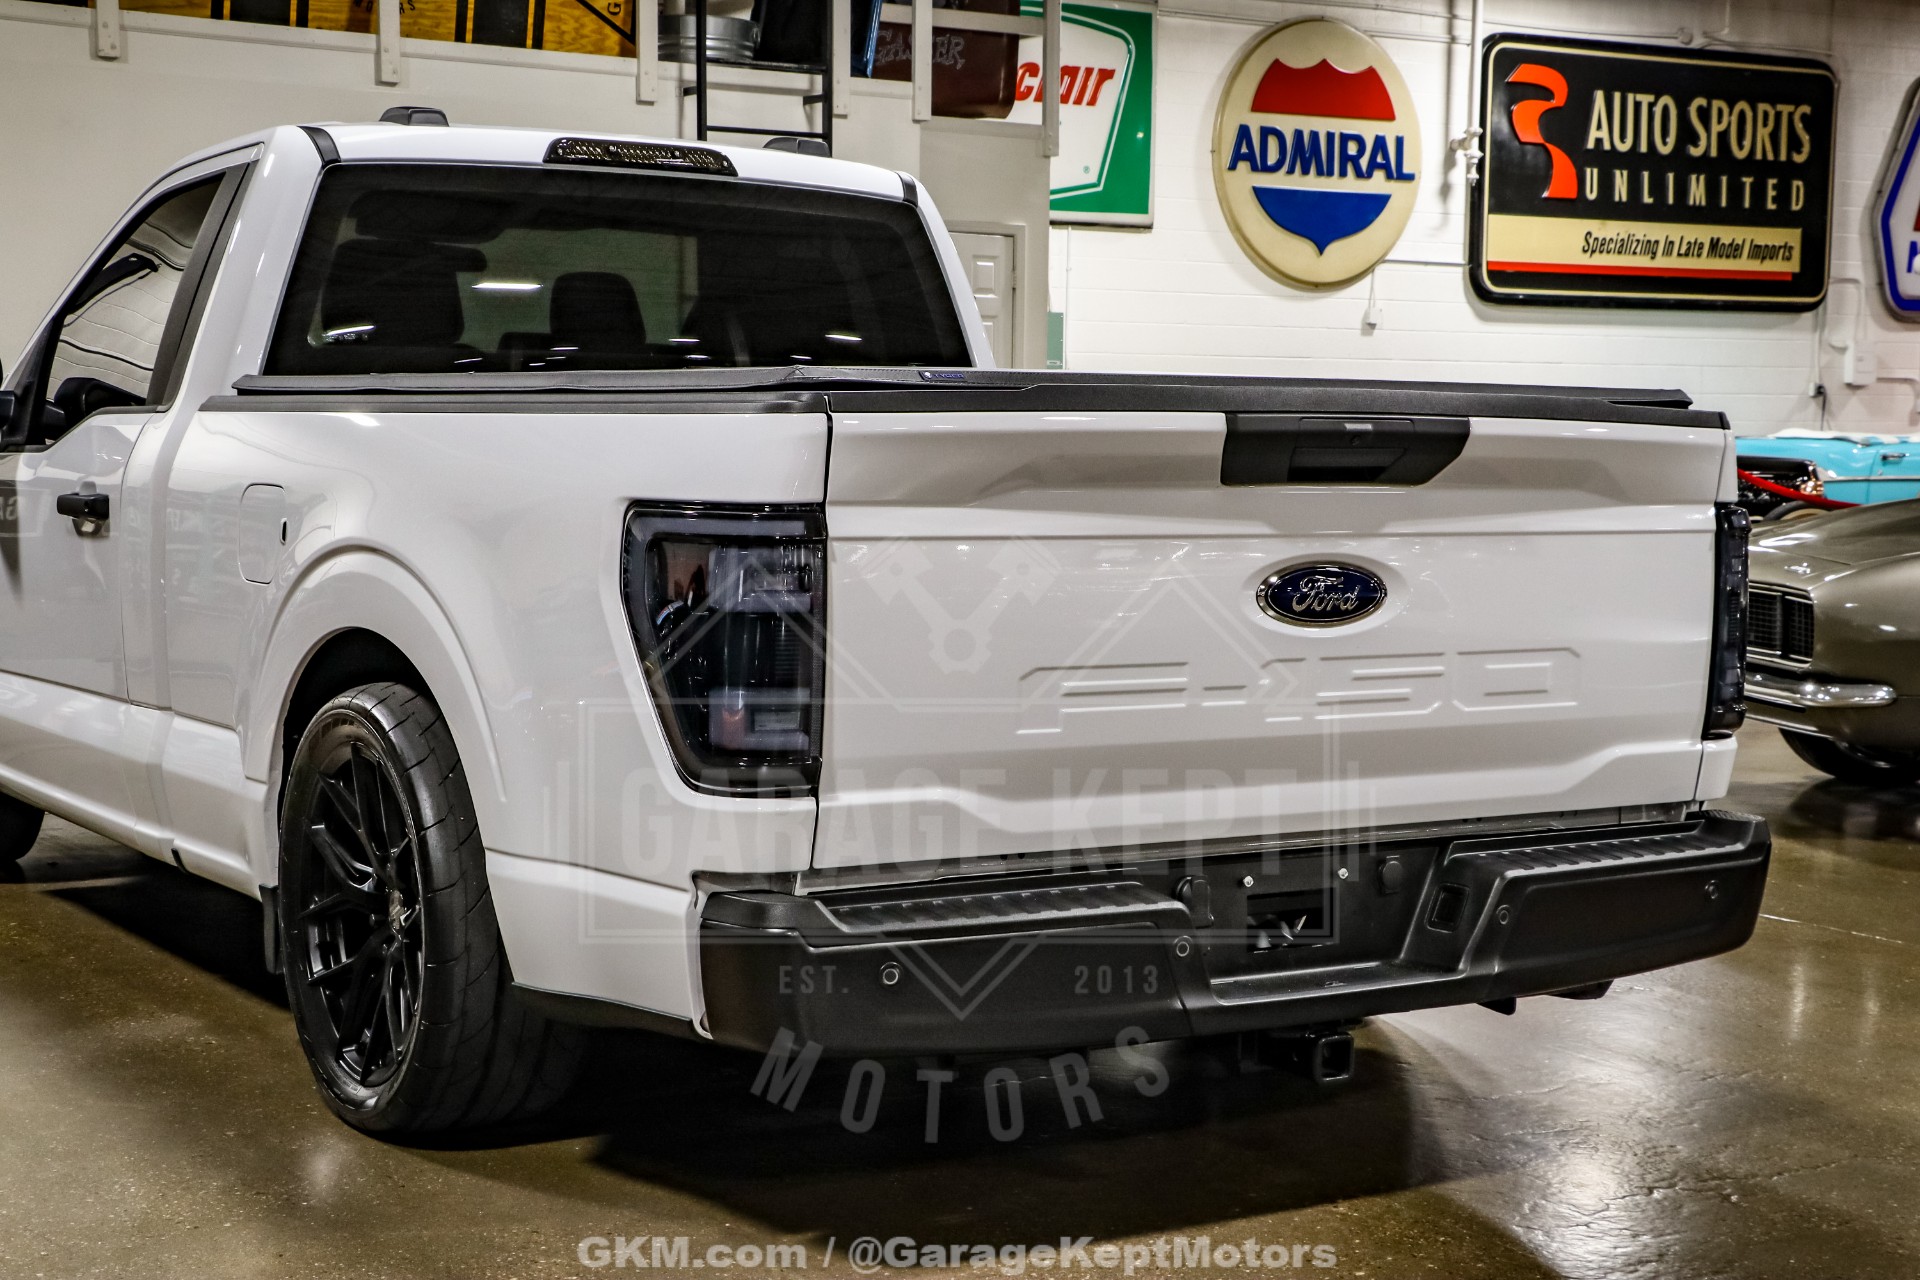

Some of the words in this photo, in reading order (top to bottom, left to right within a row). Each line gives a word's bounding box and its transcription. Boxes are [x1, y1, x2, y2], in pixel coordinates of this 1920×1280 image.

[1586, 89, 1678, 156] AUTO
[1687, 97, 1812, 164] SPORTS
[1227, 124, 1415, 182] ADMIRAL
[1585, 167, 1805, 211] UNLIMITED
[1582, 231, 1660, 260] Specializing
[1661, 234, 1675, 256] In
[1676, 235, 1704, 258] Late
[1706, 236, 1746, 259] Model
[1747, 238, 1794, 264] Imports
[1292, 575, 1360, 612] Ford
